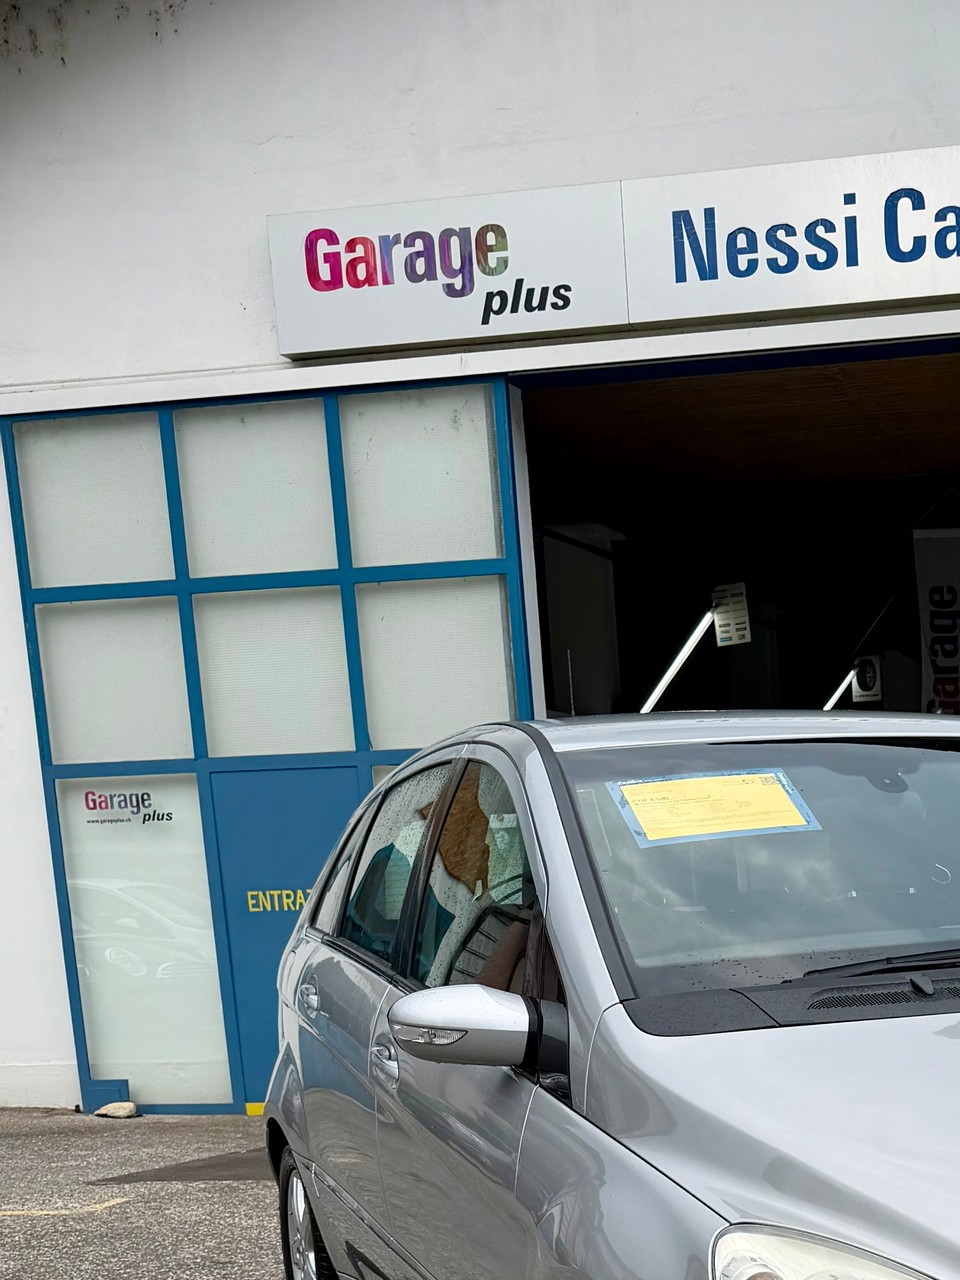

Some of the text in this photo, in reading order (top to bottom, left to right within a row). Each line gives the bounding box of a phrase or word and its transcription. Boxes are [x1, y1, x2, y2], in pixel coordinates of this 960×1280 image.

[304, 223, 509, 298] Garage
[672, 193, 859, 284] Nessi
[480, 278, 572, 326] plus
[84, 790, 152, 815] Garage
[142, 809, 174, 824] plus
